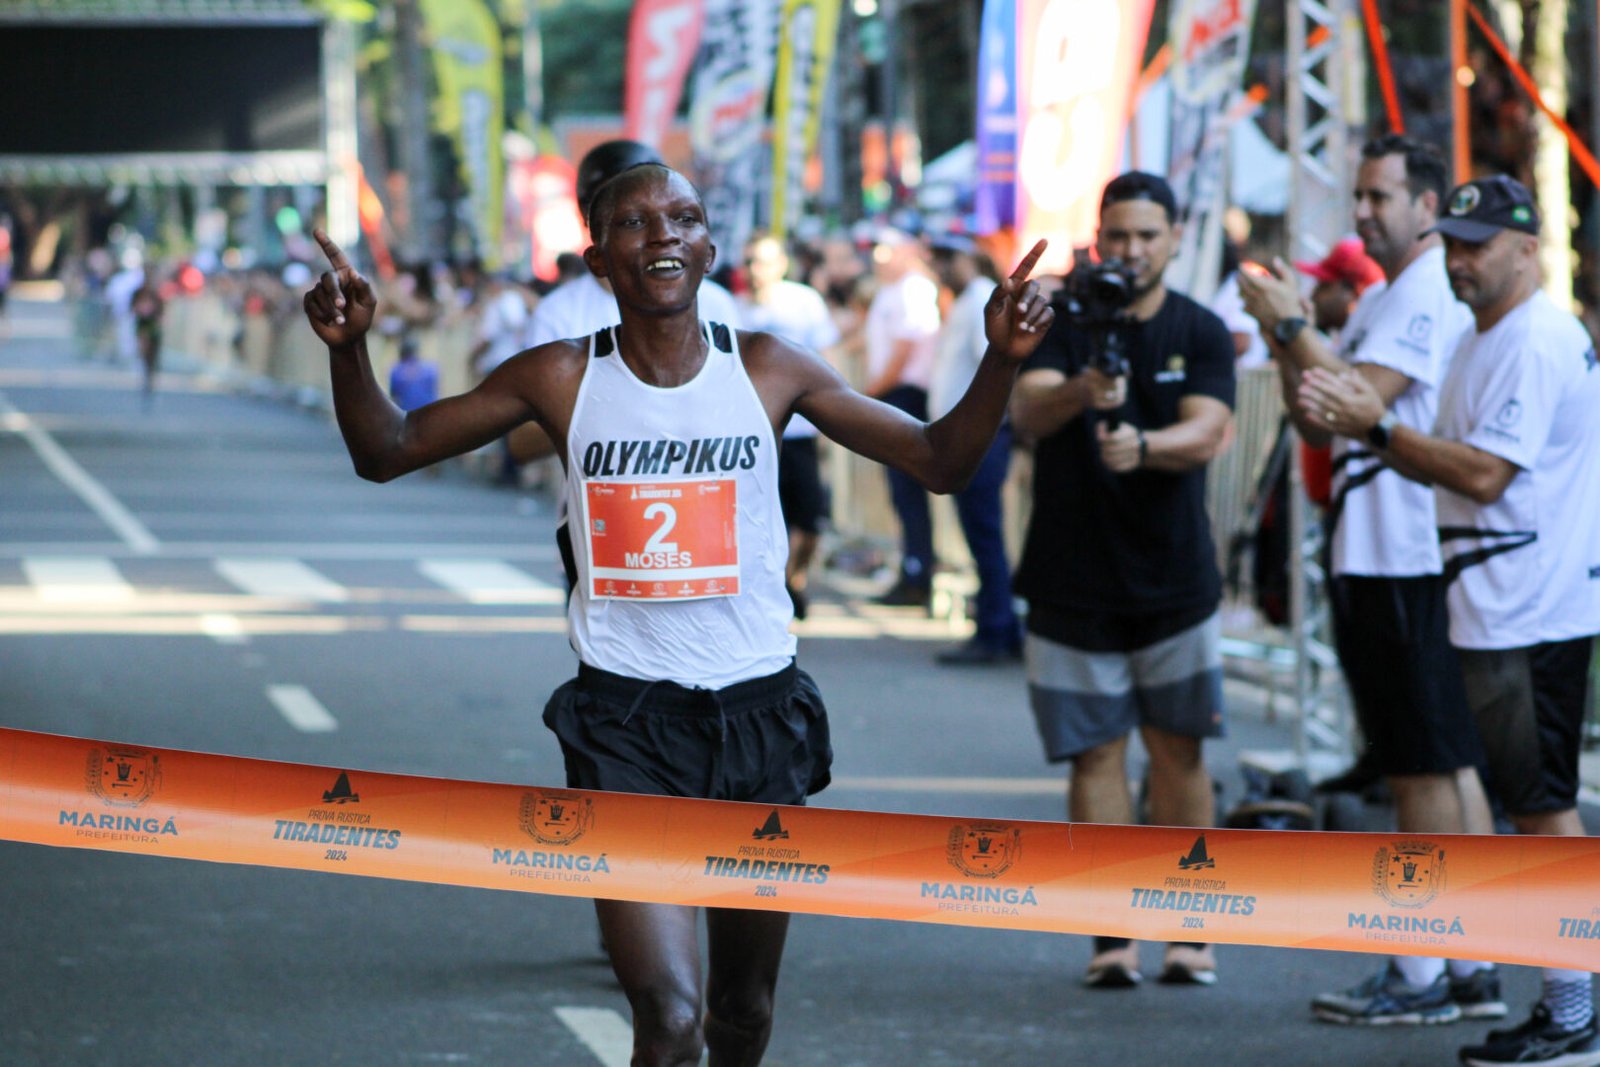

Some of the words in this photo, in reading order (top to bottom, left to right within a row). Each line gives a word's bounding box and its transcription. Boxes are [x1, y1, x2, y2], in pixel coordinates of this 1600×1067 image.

[583, 435, 760, 477] OLYMPIKUS
[643, 502, 678, 553] 2
[624, 551, 692, 568] MOSES
[58, 810, 178, 836] MARINGÁ
[273, 820, 402, 849] TIRADENTES
[75, 828, 160, 844] PREFEITURA
[324, 849, 348, 861] 2024
[492, 847, 610, 873] MARINGÁ
[509, 868, 592, 883] PREFEITURA
[703, 856, 831, 884] TIRADENTES
[754, 885, 777, 897] 2024
[920, 881, 1038, 906] MARINGÁ
[1131, 888, 1257, 916] TIRADENTES
[938, 902, 1020, 916] PREFEITURA
[1182, 917, 1205, 929] 2024
[1347, 912, 1466, 936] MARINGÁ
[1365, 931, 1447, 945] PREFEITURA
